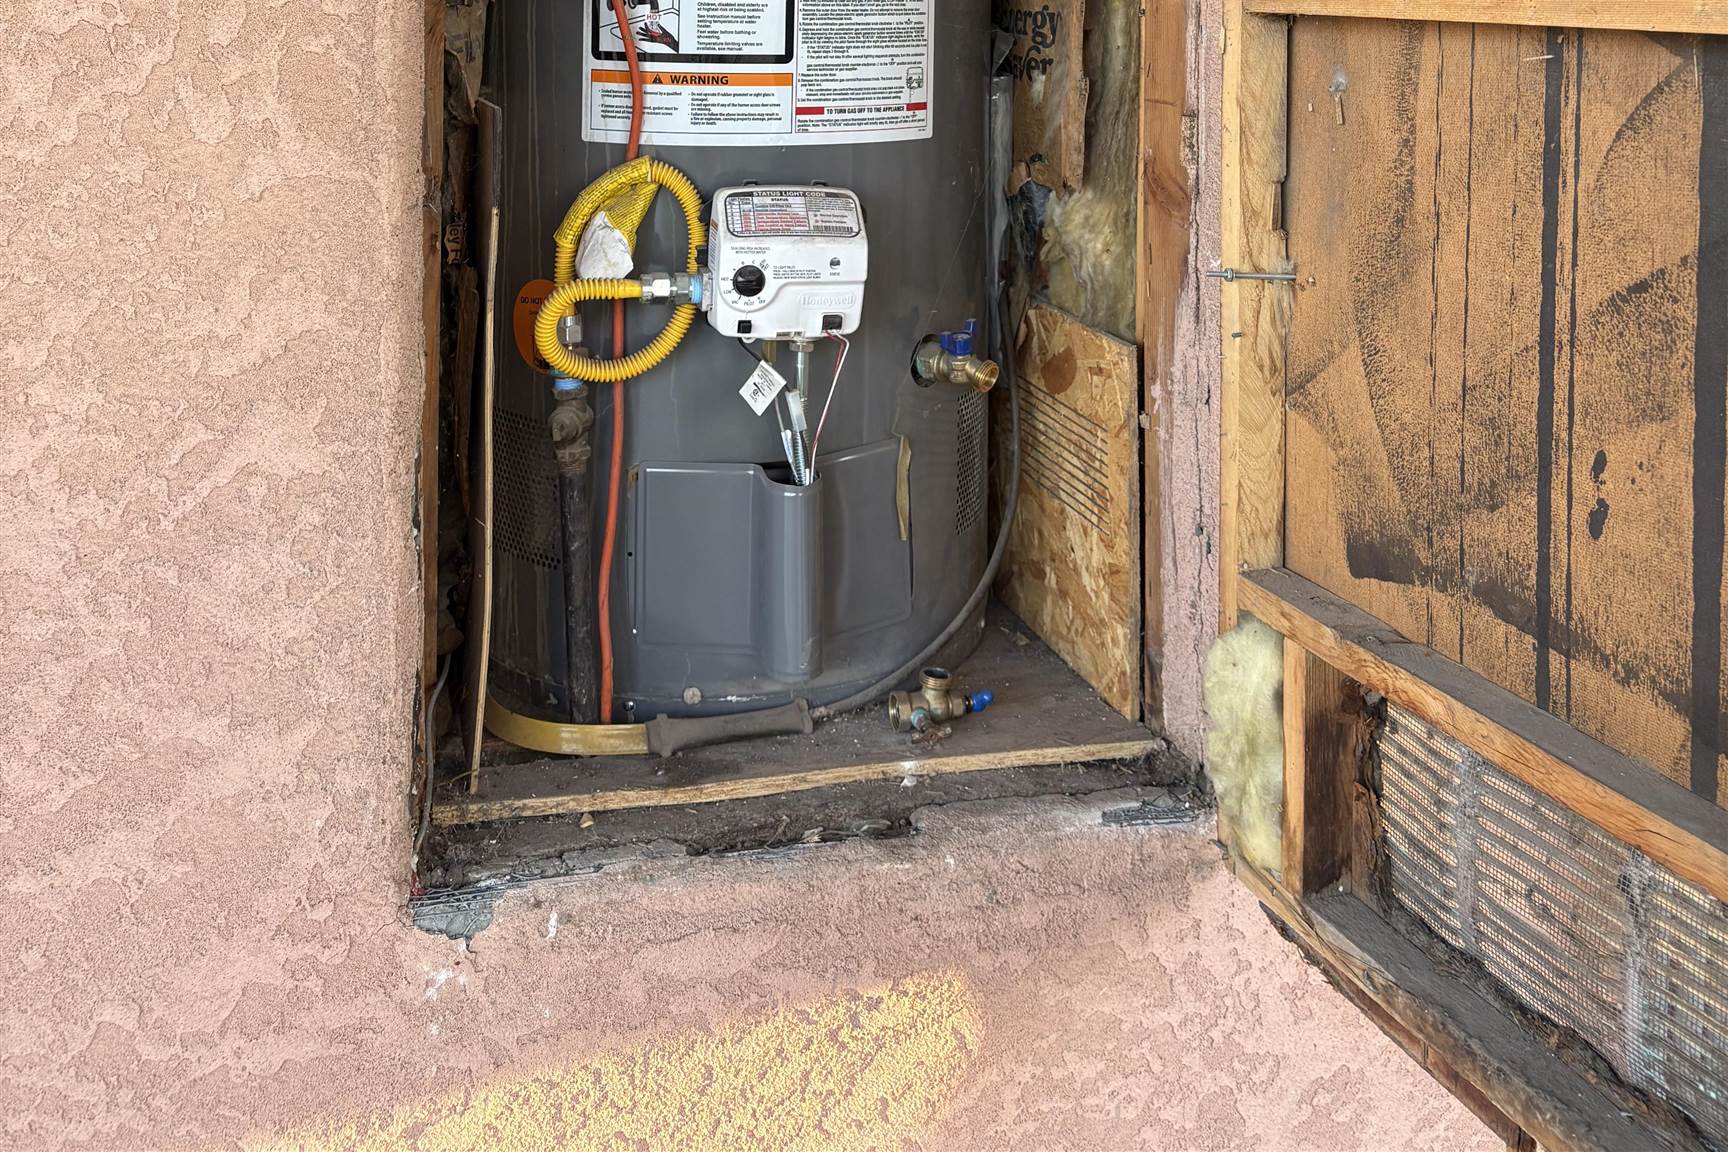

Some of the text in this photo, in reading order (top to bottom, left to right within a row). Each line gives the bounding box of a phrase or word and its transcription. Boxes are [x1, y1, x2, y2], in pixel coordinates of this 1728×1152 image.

[670, 75, 729, 85] WARNING
[883, 105, 905, 113] APPLIANCE
[520, 296, 529, 304] DO
[803, 295, 855, 307] Honeywell
